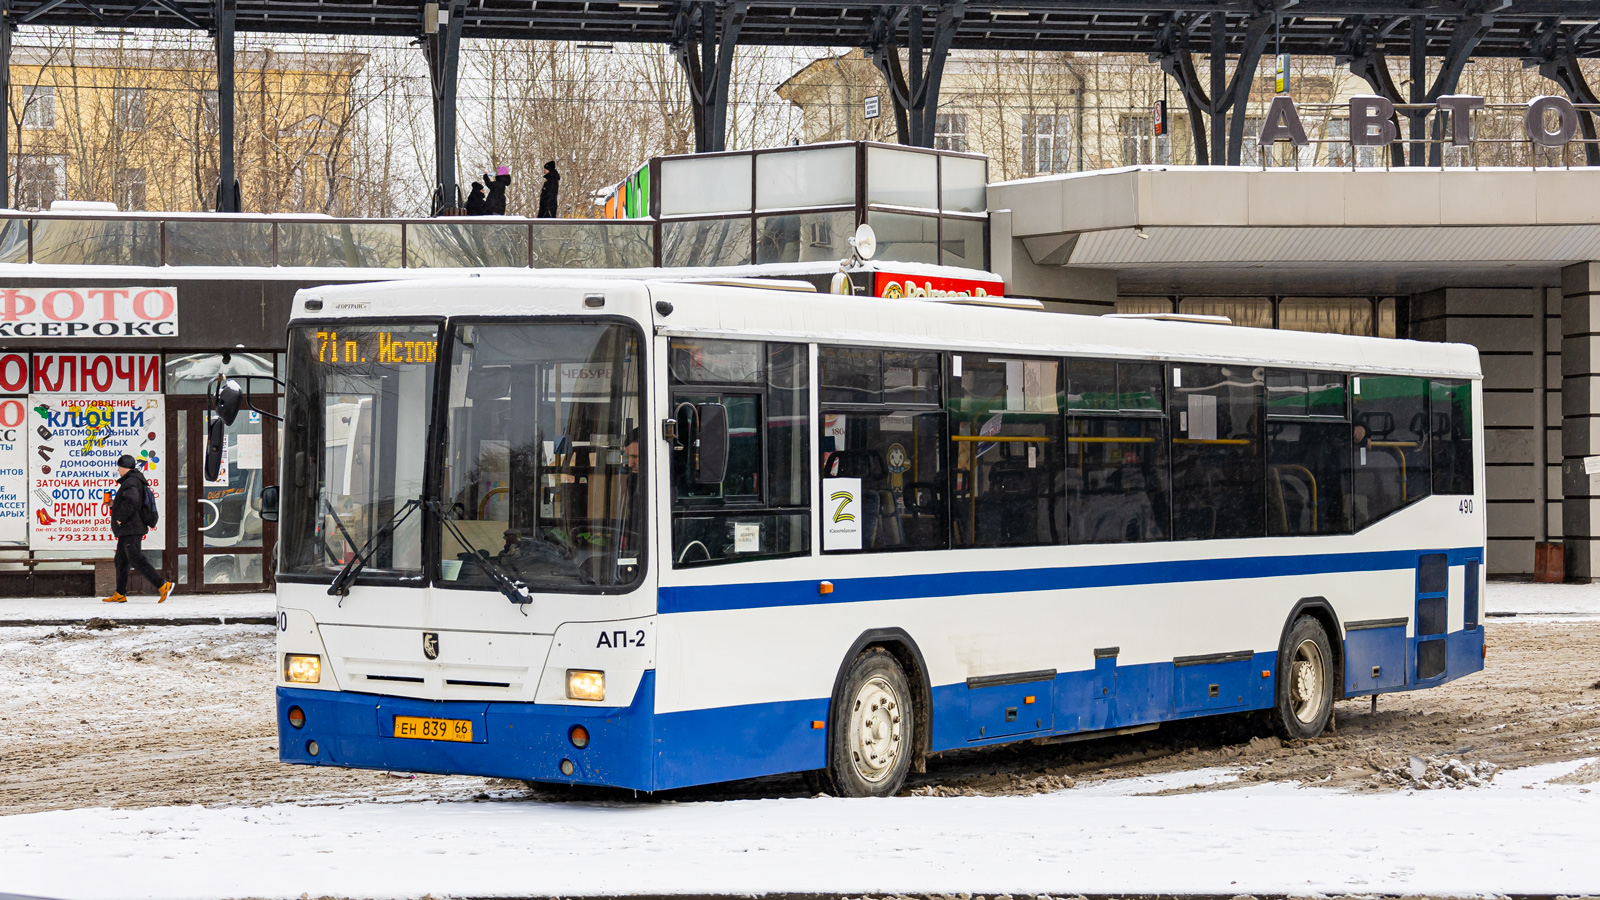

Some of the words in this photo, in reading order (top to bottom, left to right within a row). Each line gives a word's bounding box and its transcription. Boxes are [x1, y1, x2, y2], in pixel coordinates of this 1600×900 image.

[1258, 95, 1577, 147] АВТО
[0, 289, 175, 321] ФОТО
[316, 332, 339, 362] 71
[379, 332, 438, 362] Исток
[33, 355, 160, 393] КЛЮЧИ
[47, 406, 144, 428] КЛЮЧЕЙ
[52, 429, 139, 437] АВТОМОБИЛЬНЫХ
[64, 439, 128, 447] КВАРТИРНЫХ
[69, 449, 123, 457] СЕЙФОВЫХ
[60, 460, 118, 468] ДОМОФОНН
[52, 489, 85, 500] ФОТО
[54, 503, 98, 517] РЕМОНТ
[1459, 499, 1473, 514] 490
[60, 517, 91, 525] Режим
[94, 517, 112, 526] раб
[596, 630, 645, 648] АП-2
[423, 721, 447, 737] 839
[454, 722, 468, 734] 66
